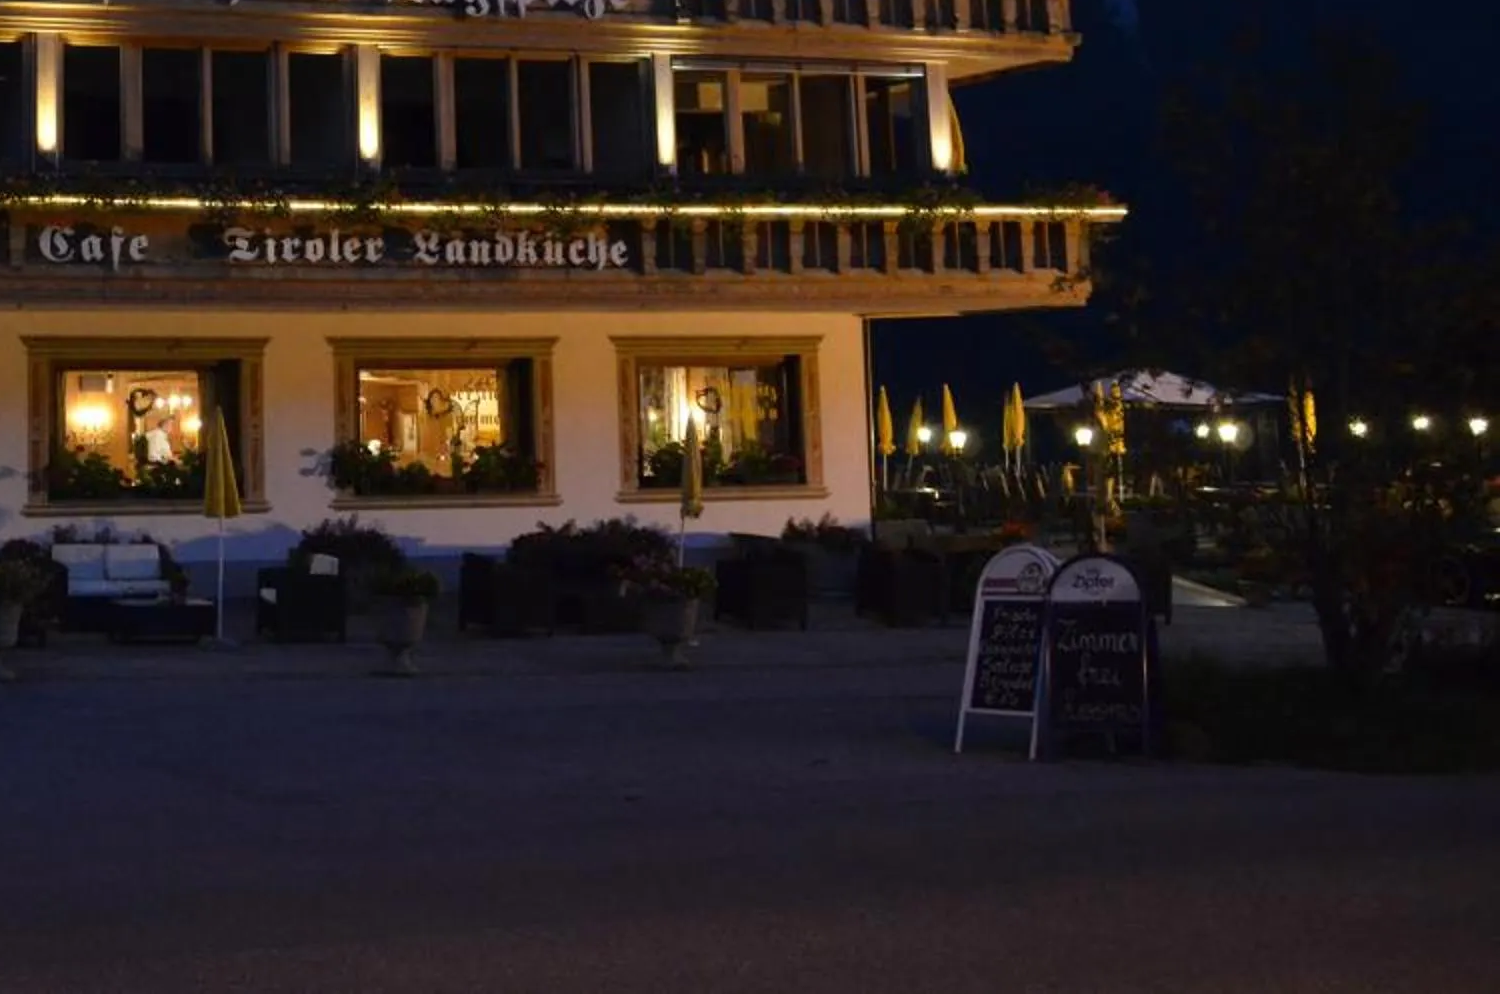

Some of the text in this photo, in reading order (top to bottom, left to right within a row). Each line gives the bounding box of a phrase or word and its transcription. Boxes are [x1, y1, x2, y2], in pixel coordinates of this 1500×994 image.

[38, 224, 149, 272] Cafe
[223, 226, 385, 264] Tiroler
[1056, 618, 1140, 654] Zimmer
